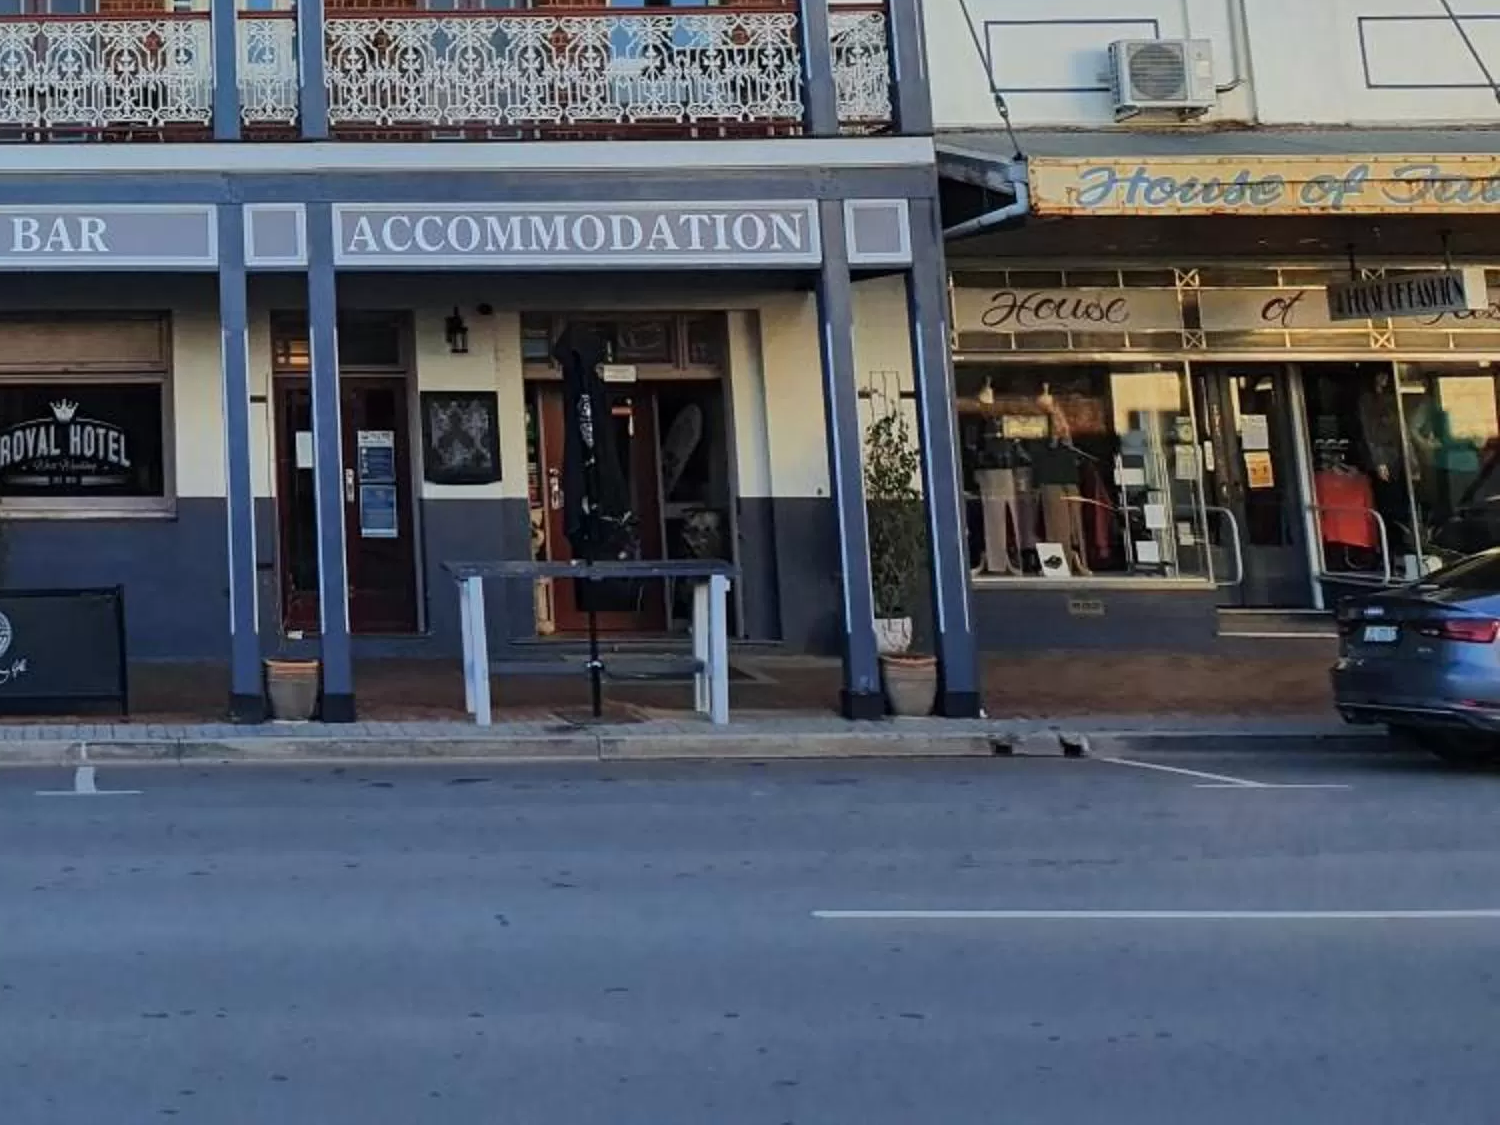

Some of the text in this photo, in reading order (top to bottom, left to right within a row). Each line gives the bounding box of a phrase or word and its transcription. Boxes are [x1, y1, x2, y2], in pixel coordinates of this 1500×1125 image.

[1076, 166, 1285, 207] House
[1302, 163, 1369, 211] of
[12, 216, 110, 253] BAR
[348, 212, 803, 252] ACCOMMODATION
[981, 291, 1131, 328] House
[1262, 289, 1306, 328] of
[0, 424, 130, 468] ROYAL HOTEL
